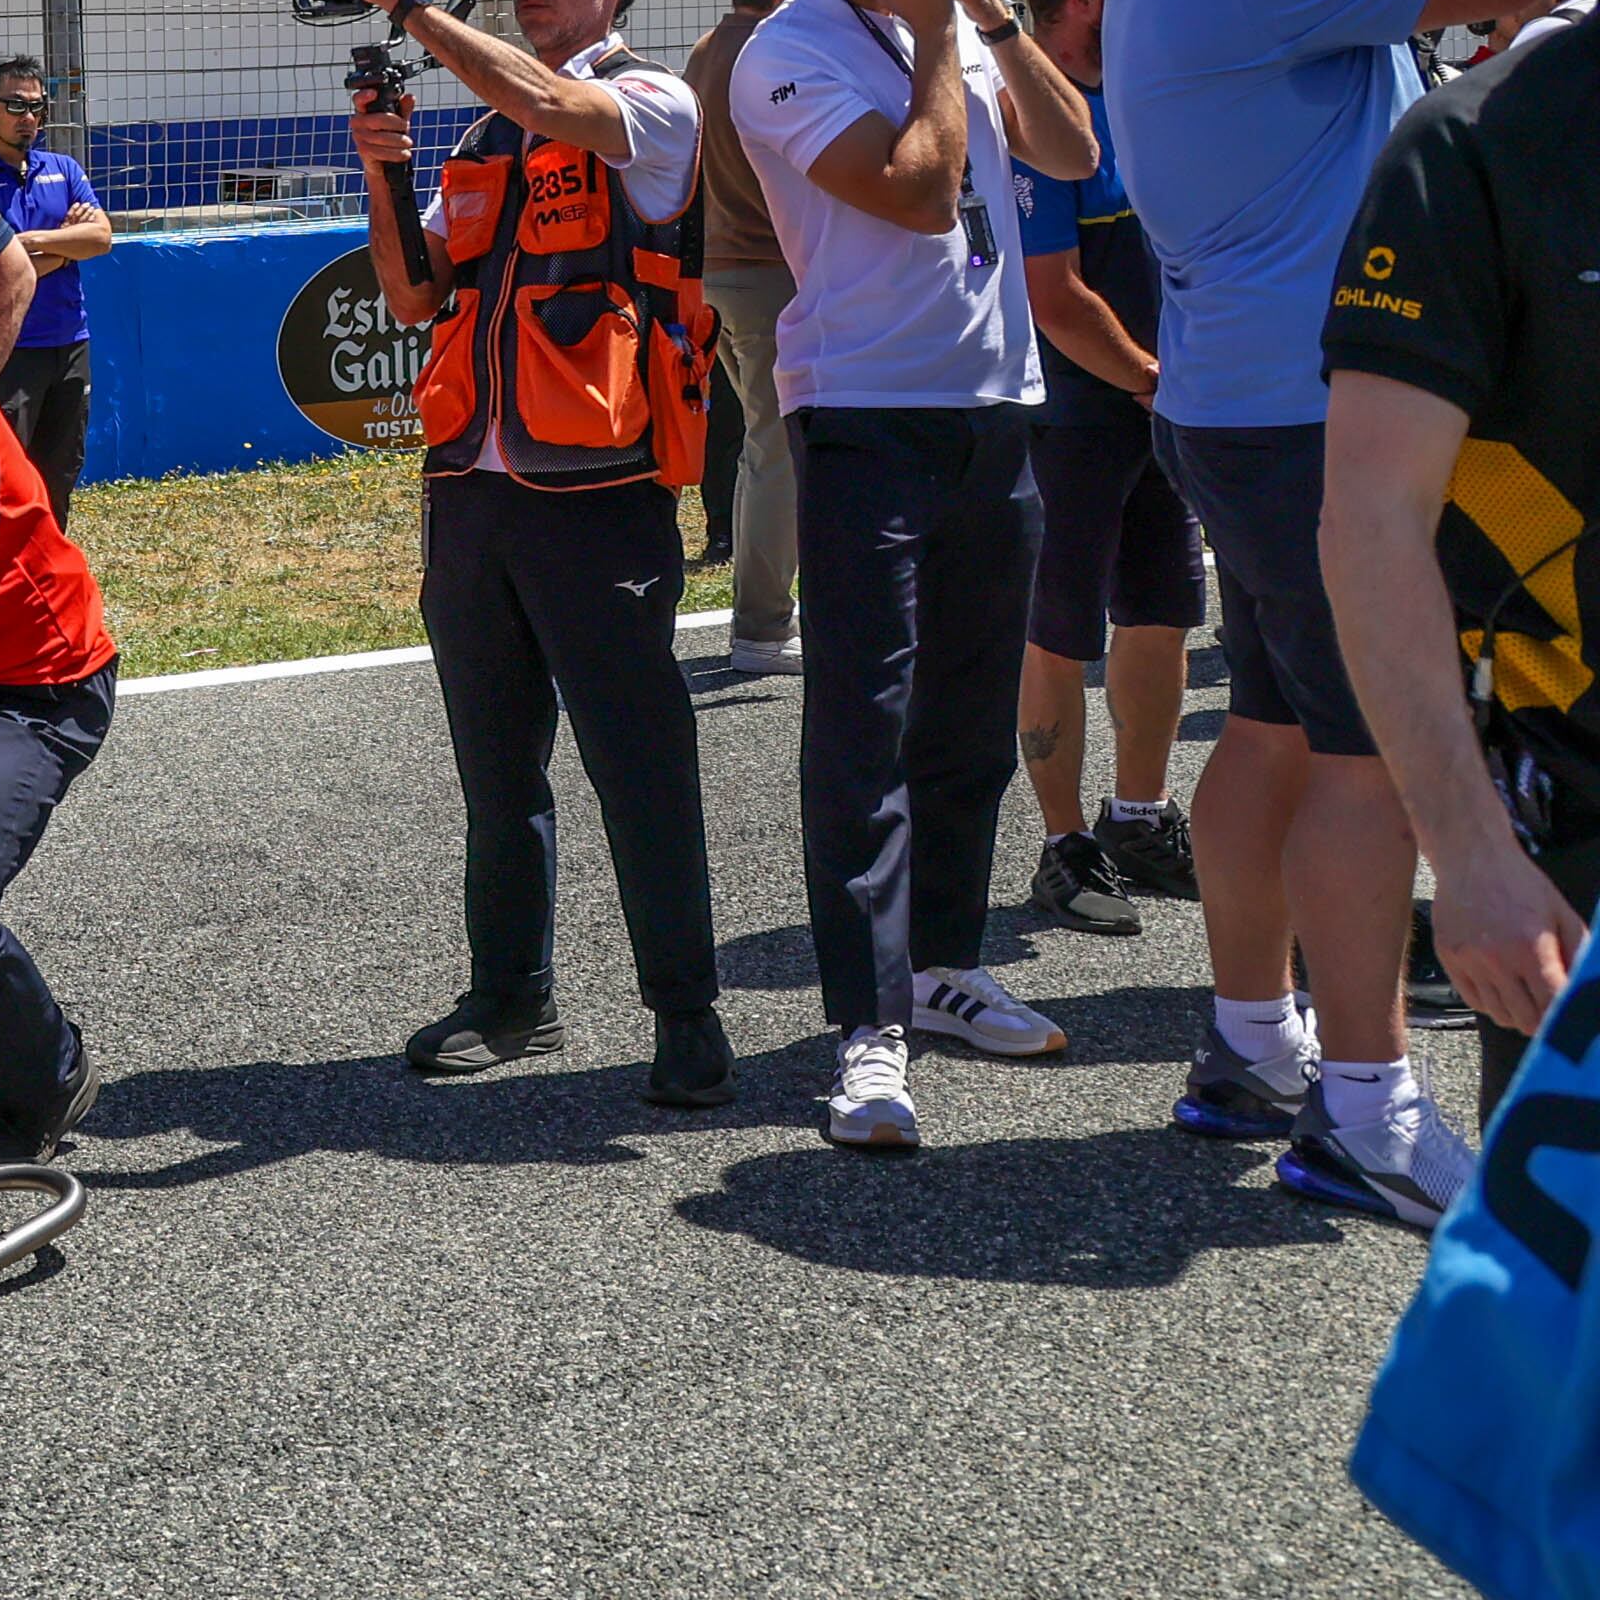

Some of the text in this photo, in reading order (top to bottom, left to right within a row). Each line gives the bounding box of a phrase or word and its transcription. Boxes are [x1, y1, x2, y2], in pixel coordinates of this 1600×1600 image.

[769, 81, 796, 105] FIM
[531, 163, 582, 203] 235
[363, 418, 424, 439] TOSTA
[1119, 803, 1158, 816] adida
